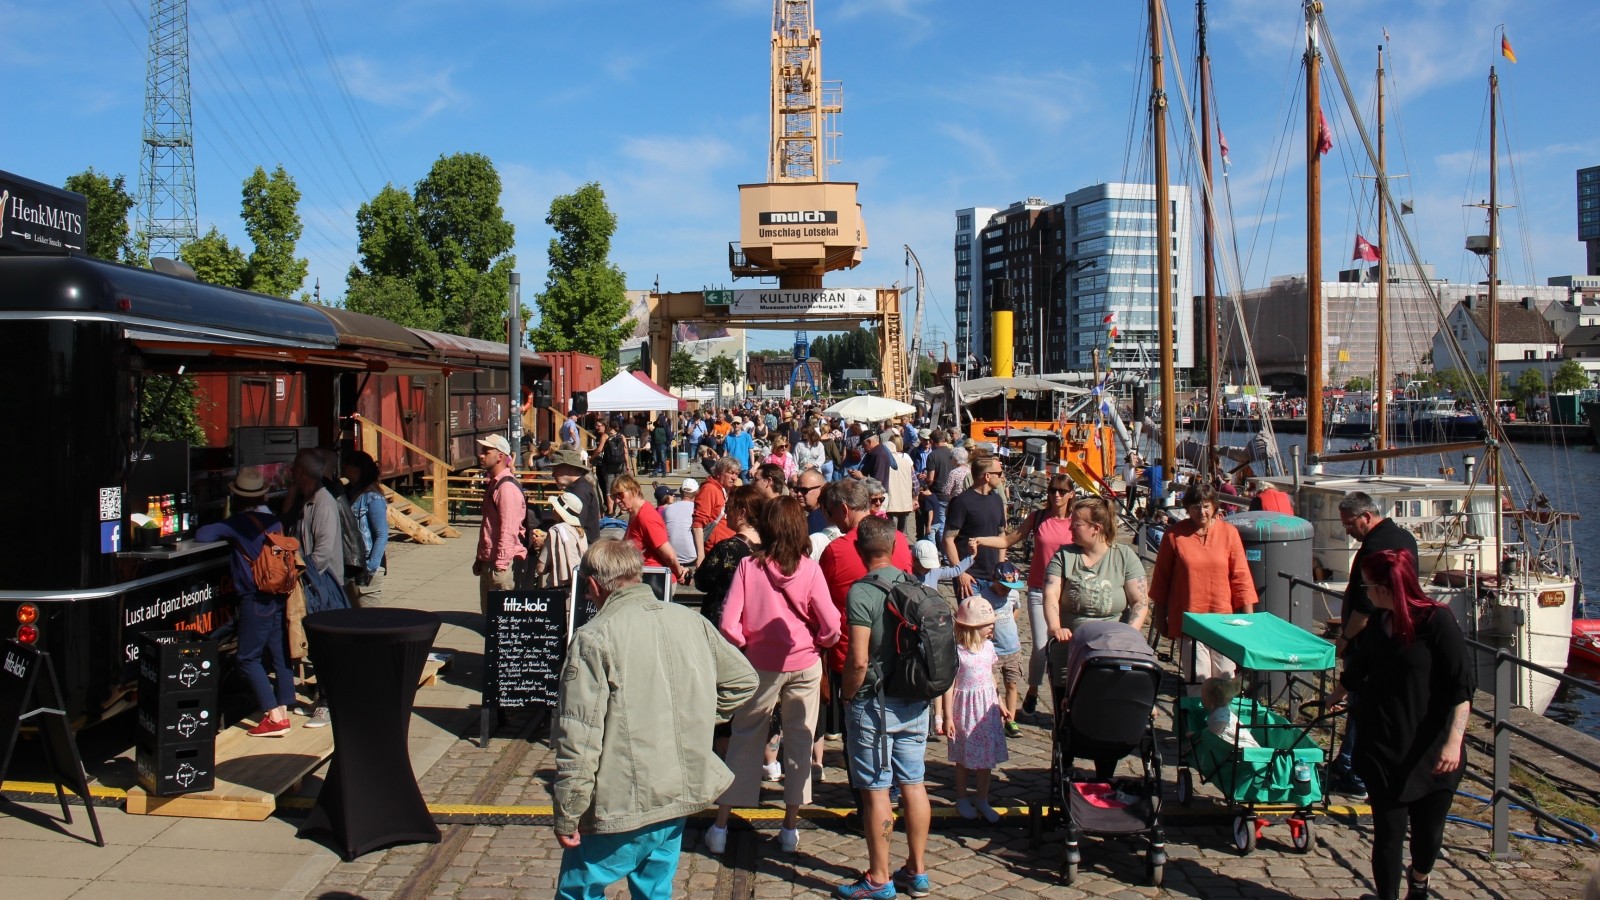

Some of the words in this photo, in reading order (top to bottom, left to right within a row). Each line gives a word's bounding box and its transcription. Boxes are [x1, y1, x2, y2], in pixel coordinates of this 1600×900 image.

[11, 196, 82, 235] HenkMATS
[770, 211, 826, 223] mulch
[759, 228, 801, 238] Umschlag
[803, 227, 839, 237] Lotsekai
[759, 293, 846, 304] KULTURKRAN
[125, 606, 145, 627] Lust
[145, 597, 161, 619] auf
[161, 597, 181, 619] ganz
[125, 644, 140, 662] Sie
